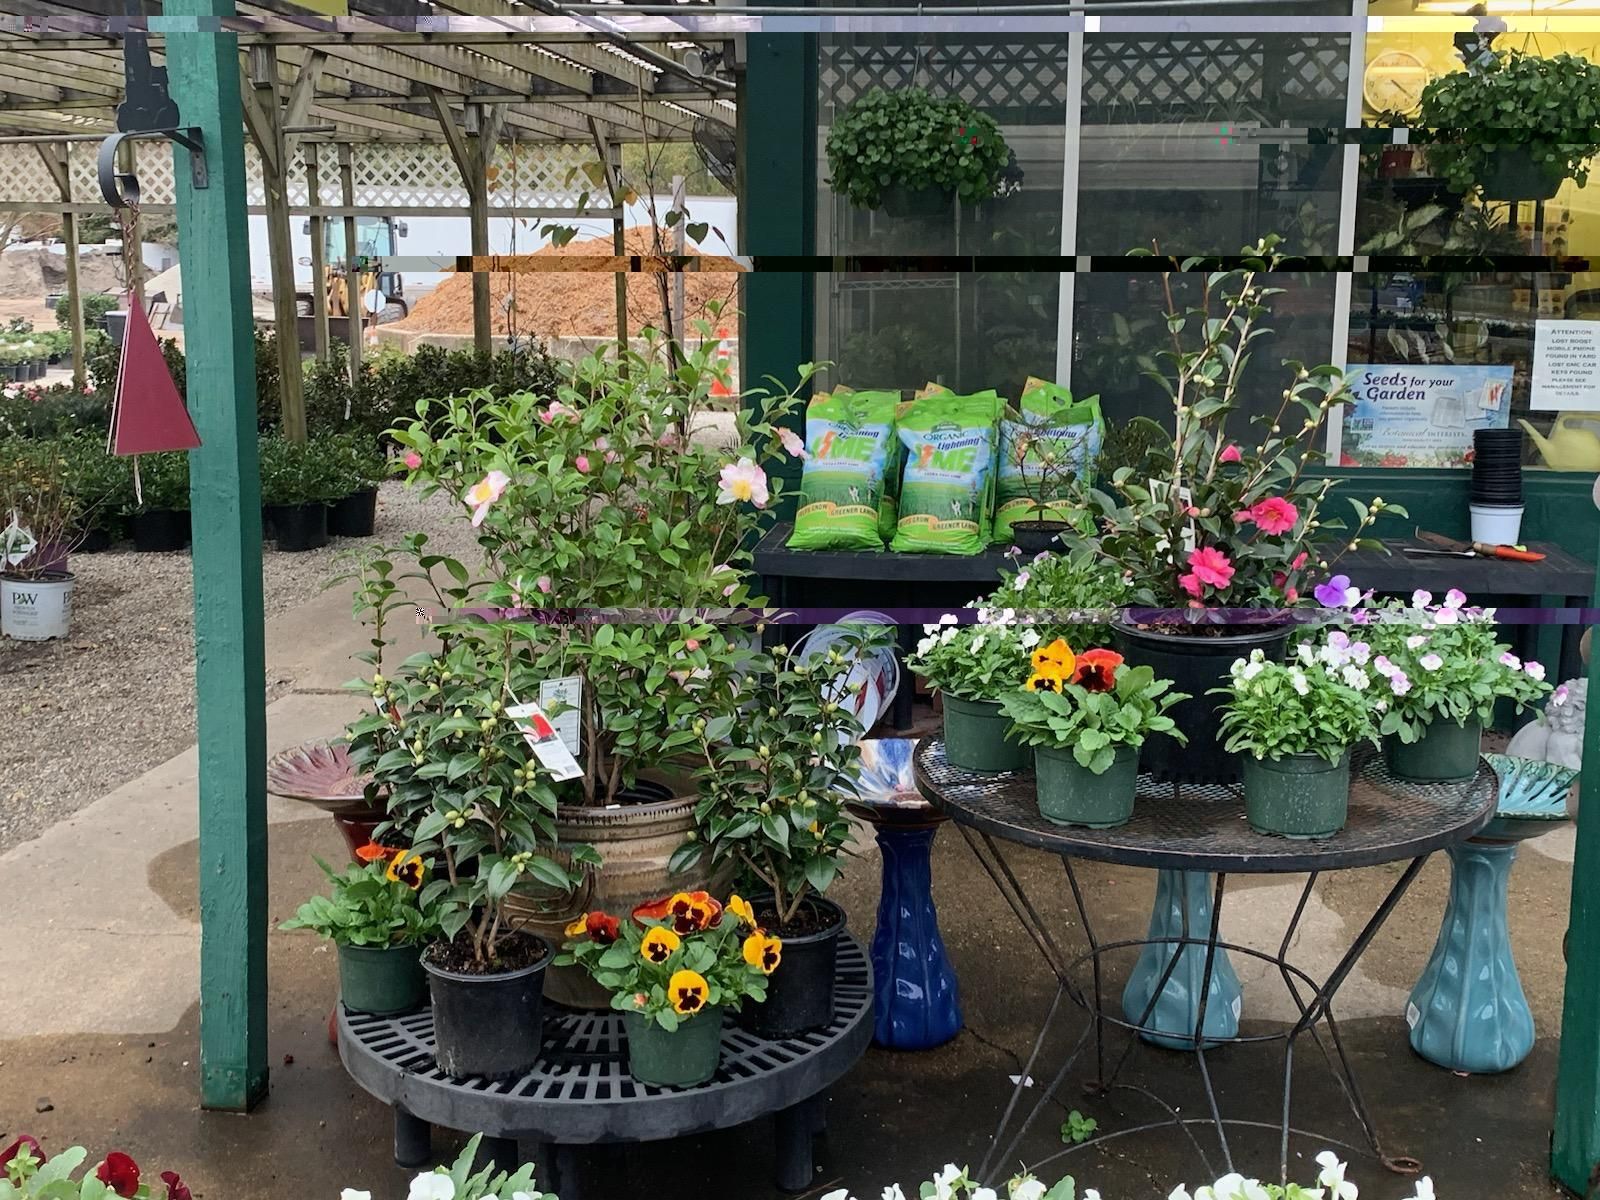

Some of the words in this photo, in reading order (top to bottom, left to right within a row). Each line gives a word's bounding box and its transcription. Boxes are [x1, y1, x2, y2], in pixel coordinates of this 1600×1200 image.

[1363, 372, 1407, 386] Seeds
[1409, 376, 1426, 388] for
[1429, 379, 1455, 388] your
[1366, 386, 1426, 402] Garden
[923, 431, 968, 441] ORGANIC
[937, 437, 980, 450] Lightning
